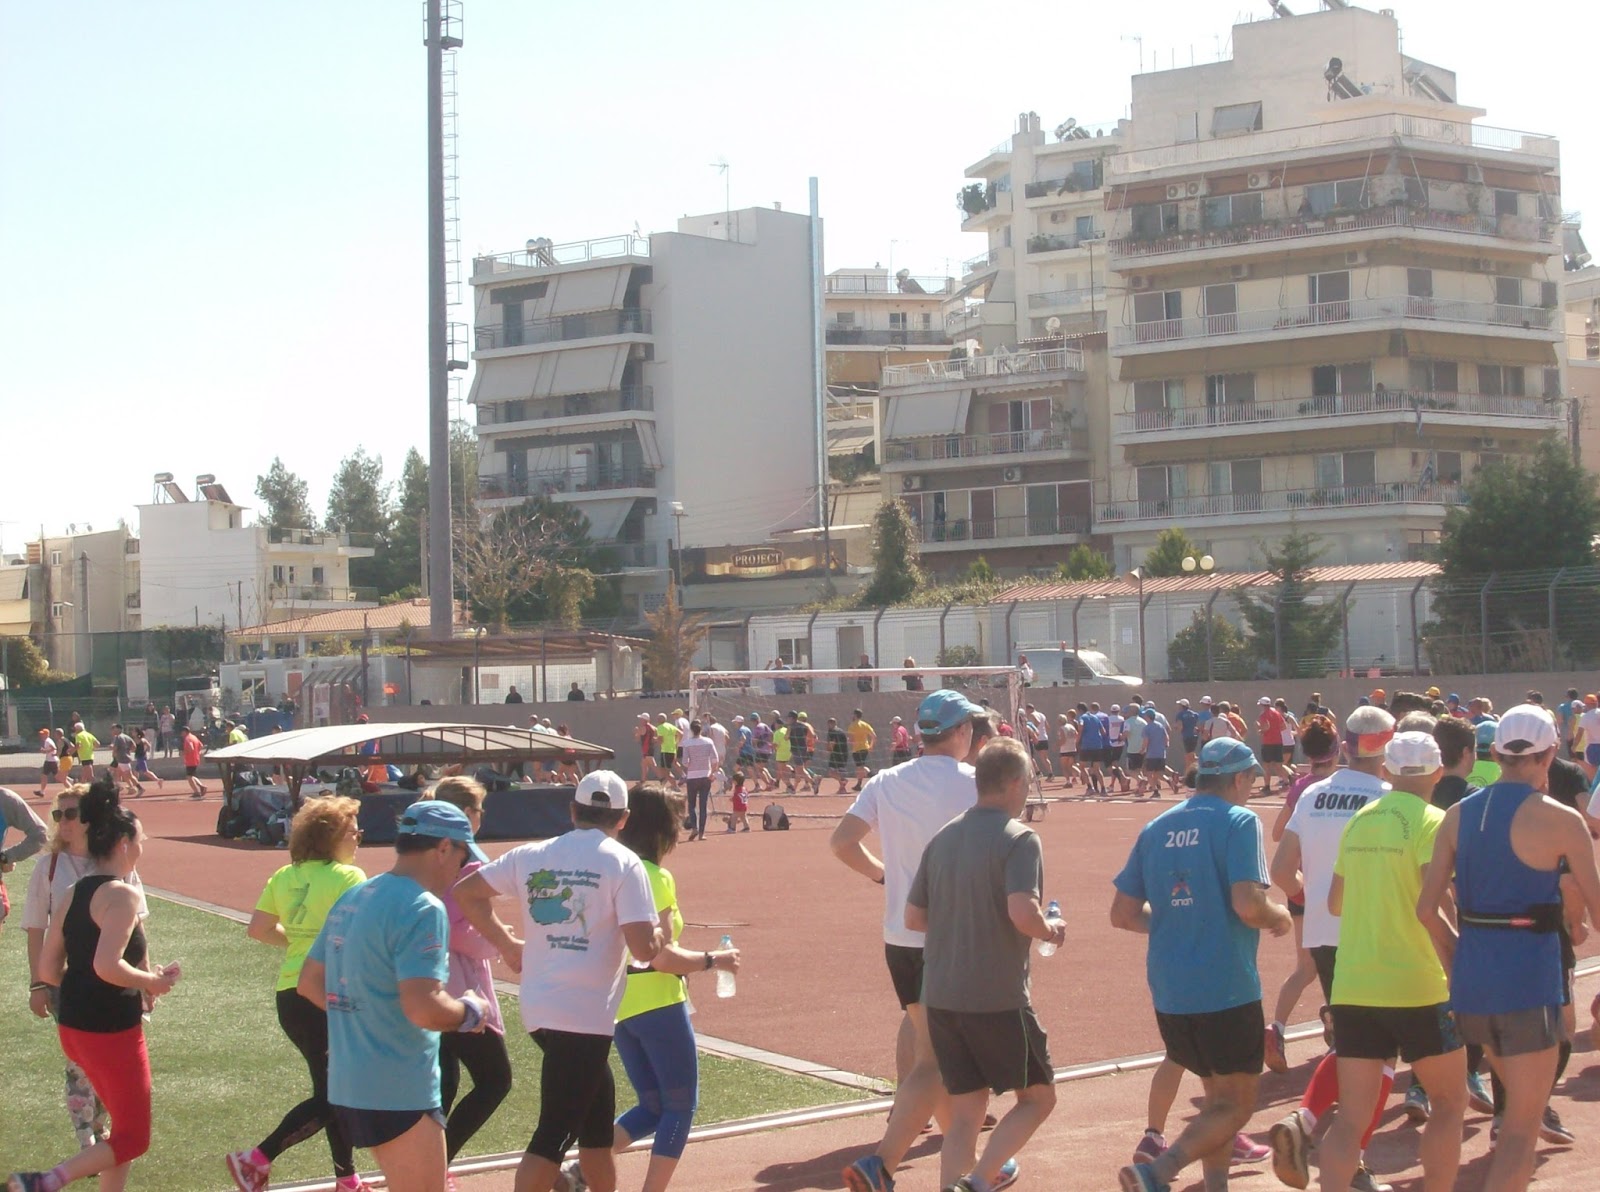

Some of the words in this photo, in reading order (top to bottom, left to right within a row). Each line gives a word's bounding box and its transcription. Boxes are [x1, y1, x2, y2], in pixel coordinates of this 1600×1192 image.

[735, 553, 780, 565] PROJECT
[1314, 792, 1368, 810] 80KM
[1165, 828, 1200, 848] 2012
